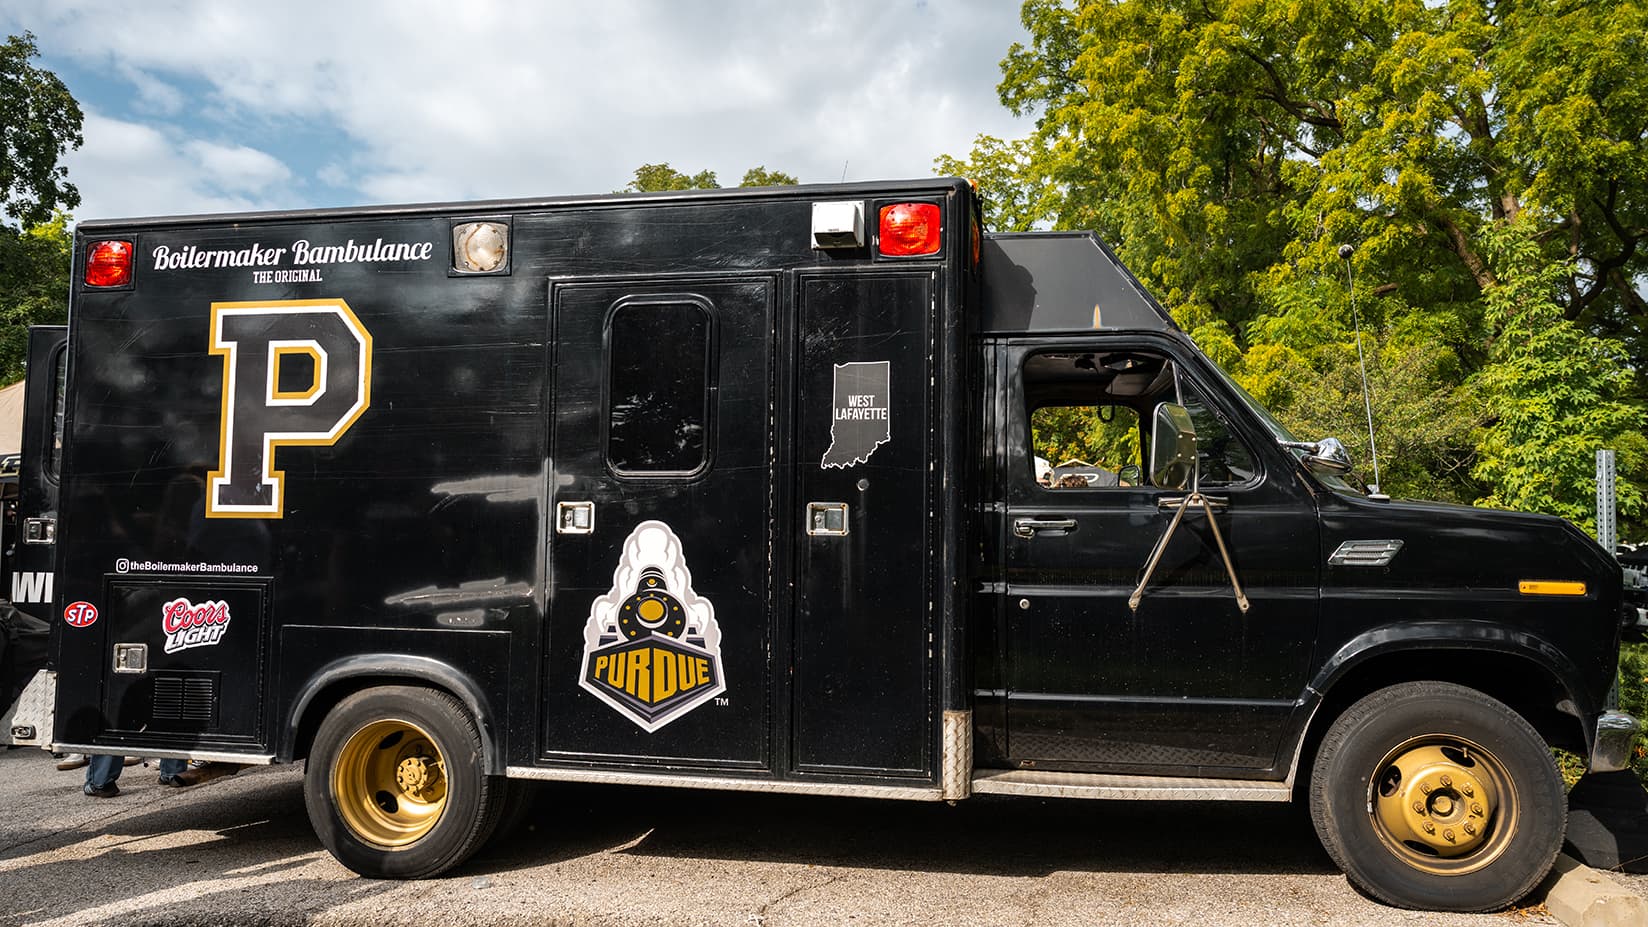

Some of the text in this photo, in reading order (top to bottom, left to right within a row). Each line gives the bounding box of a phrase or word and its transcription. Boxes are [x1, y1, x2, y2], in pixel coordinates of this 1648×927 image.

[152, 238, 433, 271] Boilermaker Bambulance
[252, 269, 323, 284] THE ORIGINAL
[205, 298, 373, 519] P
[848, 394, 876, 408] WEST
[835, 407, 888, 421] LAFAYETTE
[130, 560, 259, 574] theBoilermakerBambulance
[66, 605, 96, 625] STP
[164, 600, 229, 633] Coors
[165, 624, 226, 652] LIGHT
[594, 647, 711, 704] PURDUE
[715, 697, 729, 707] TM
